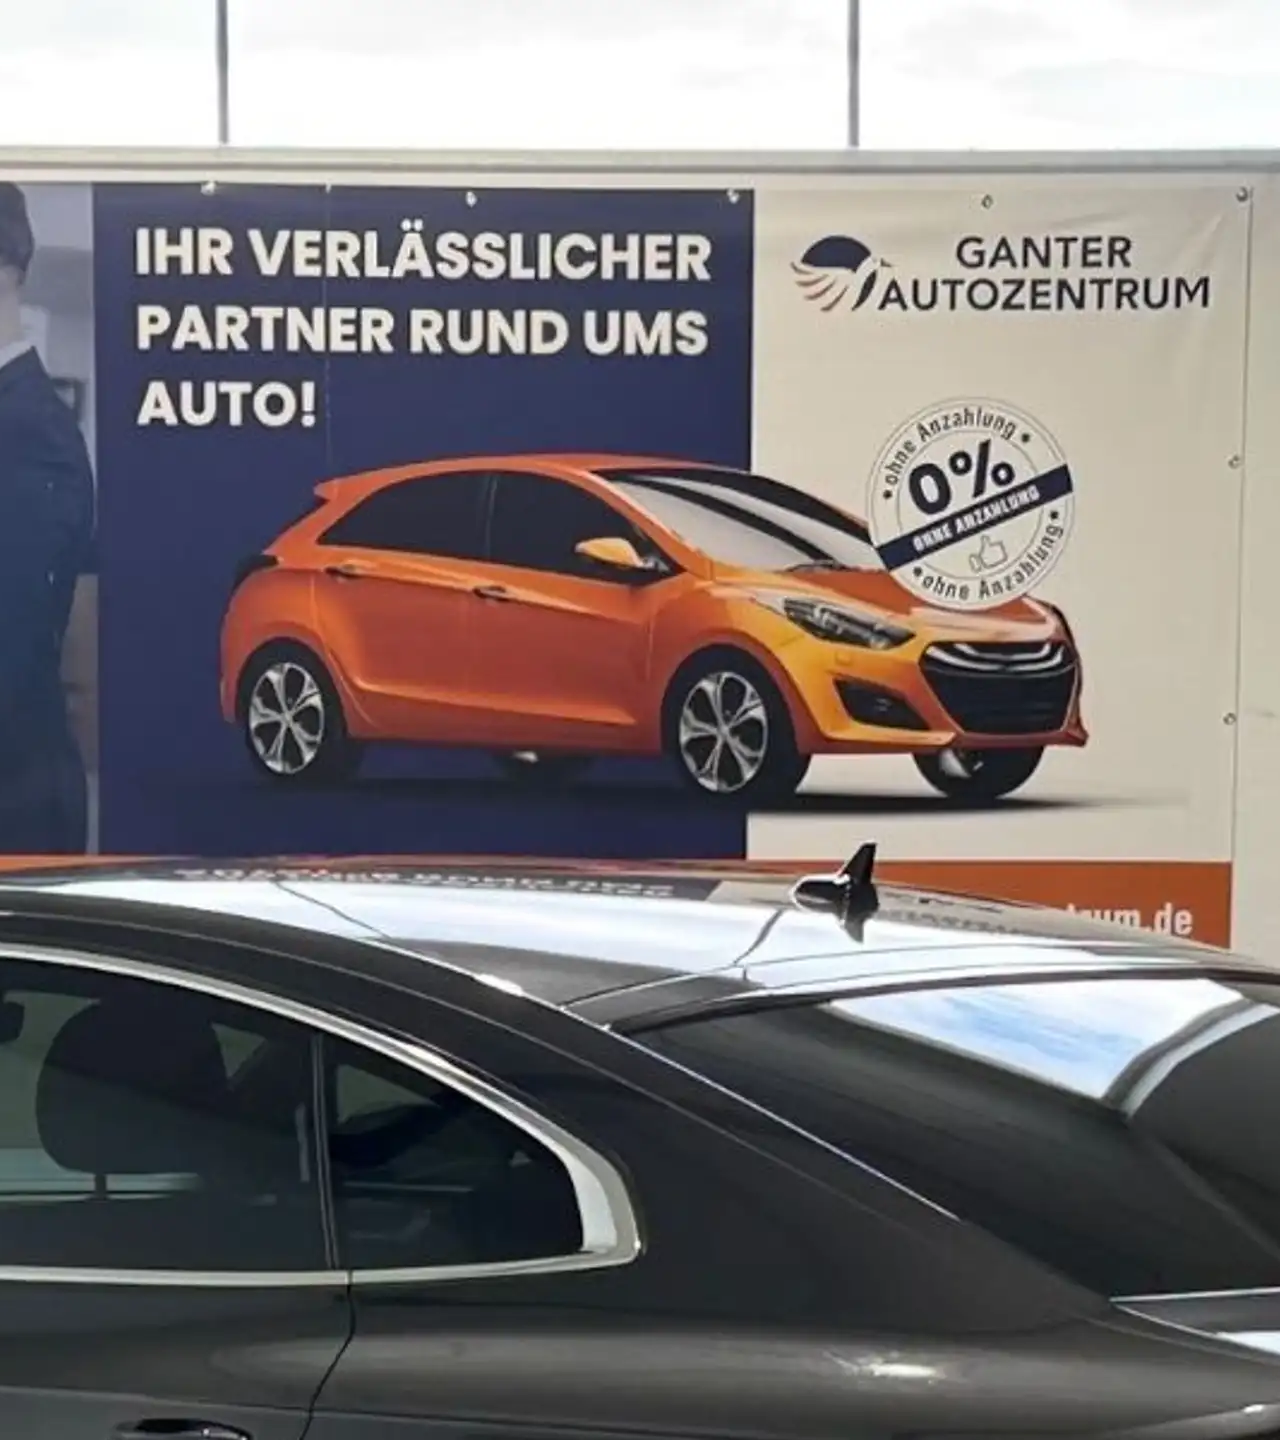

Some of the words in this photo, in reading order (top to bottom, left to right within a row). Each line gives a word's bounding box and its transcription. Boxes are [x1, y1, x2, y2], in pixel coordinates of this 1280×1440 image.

[135, 228, 234, 276] IHR
[248, 218, 712, 282] VERLÄSSLICHER
[955, 235, 1132, 270] GANTER
[877, 276, 1212, 312] AUTOZENTRUM
[136, 304, 395, 353] PARTNER
[409, 309, 570, 355] RUND
[584, 310, 709, 357] UMS
[136, 380, 317, 428] AUTO!
[885, 438, 918, 487] ohne
[916, 407, 1018, 443] Anzahlung
[908, 437, 1016, 515] 0%
[912, 523, 954, 552] OHNE
[954, 484, 1041, 533] ANZAHLUNG
[921, 574, 970, 600] ohne
[978, 523, 1064, 600] Anzahlung
